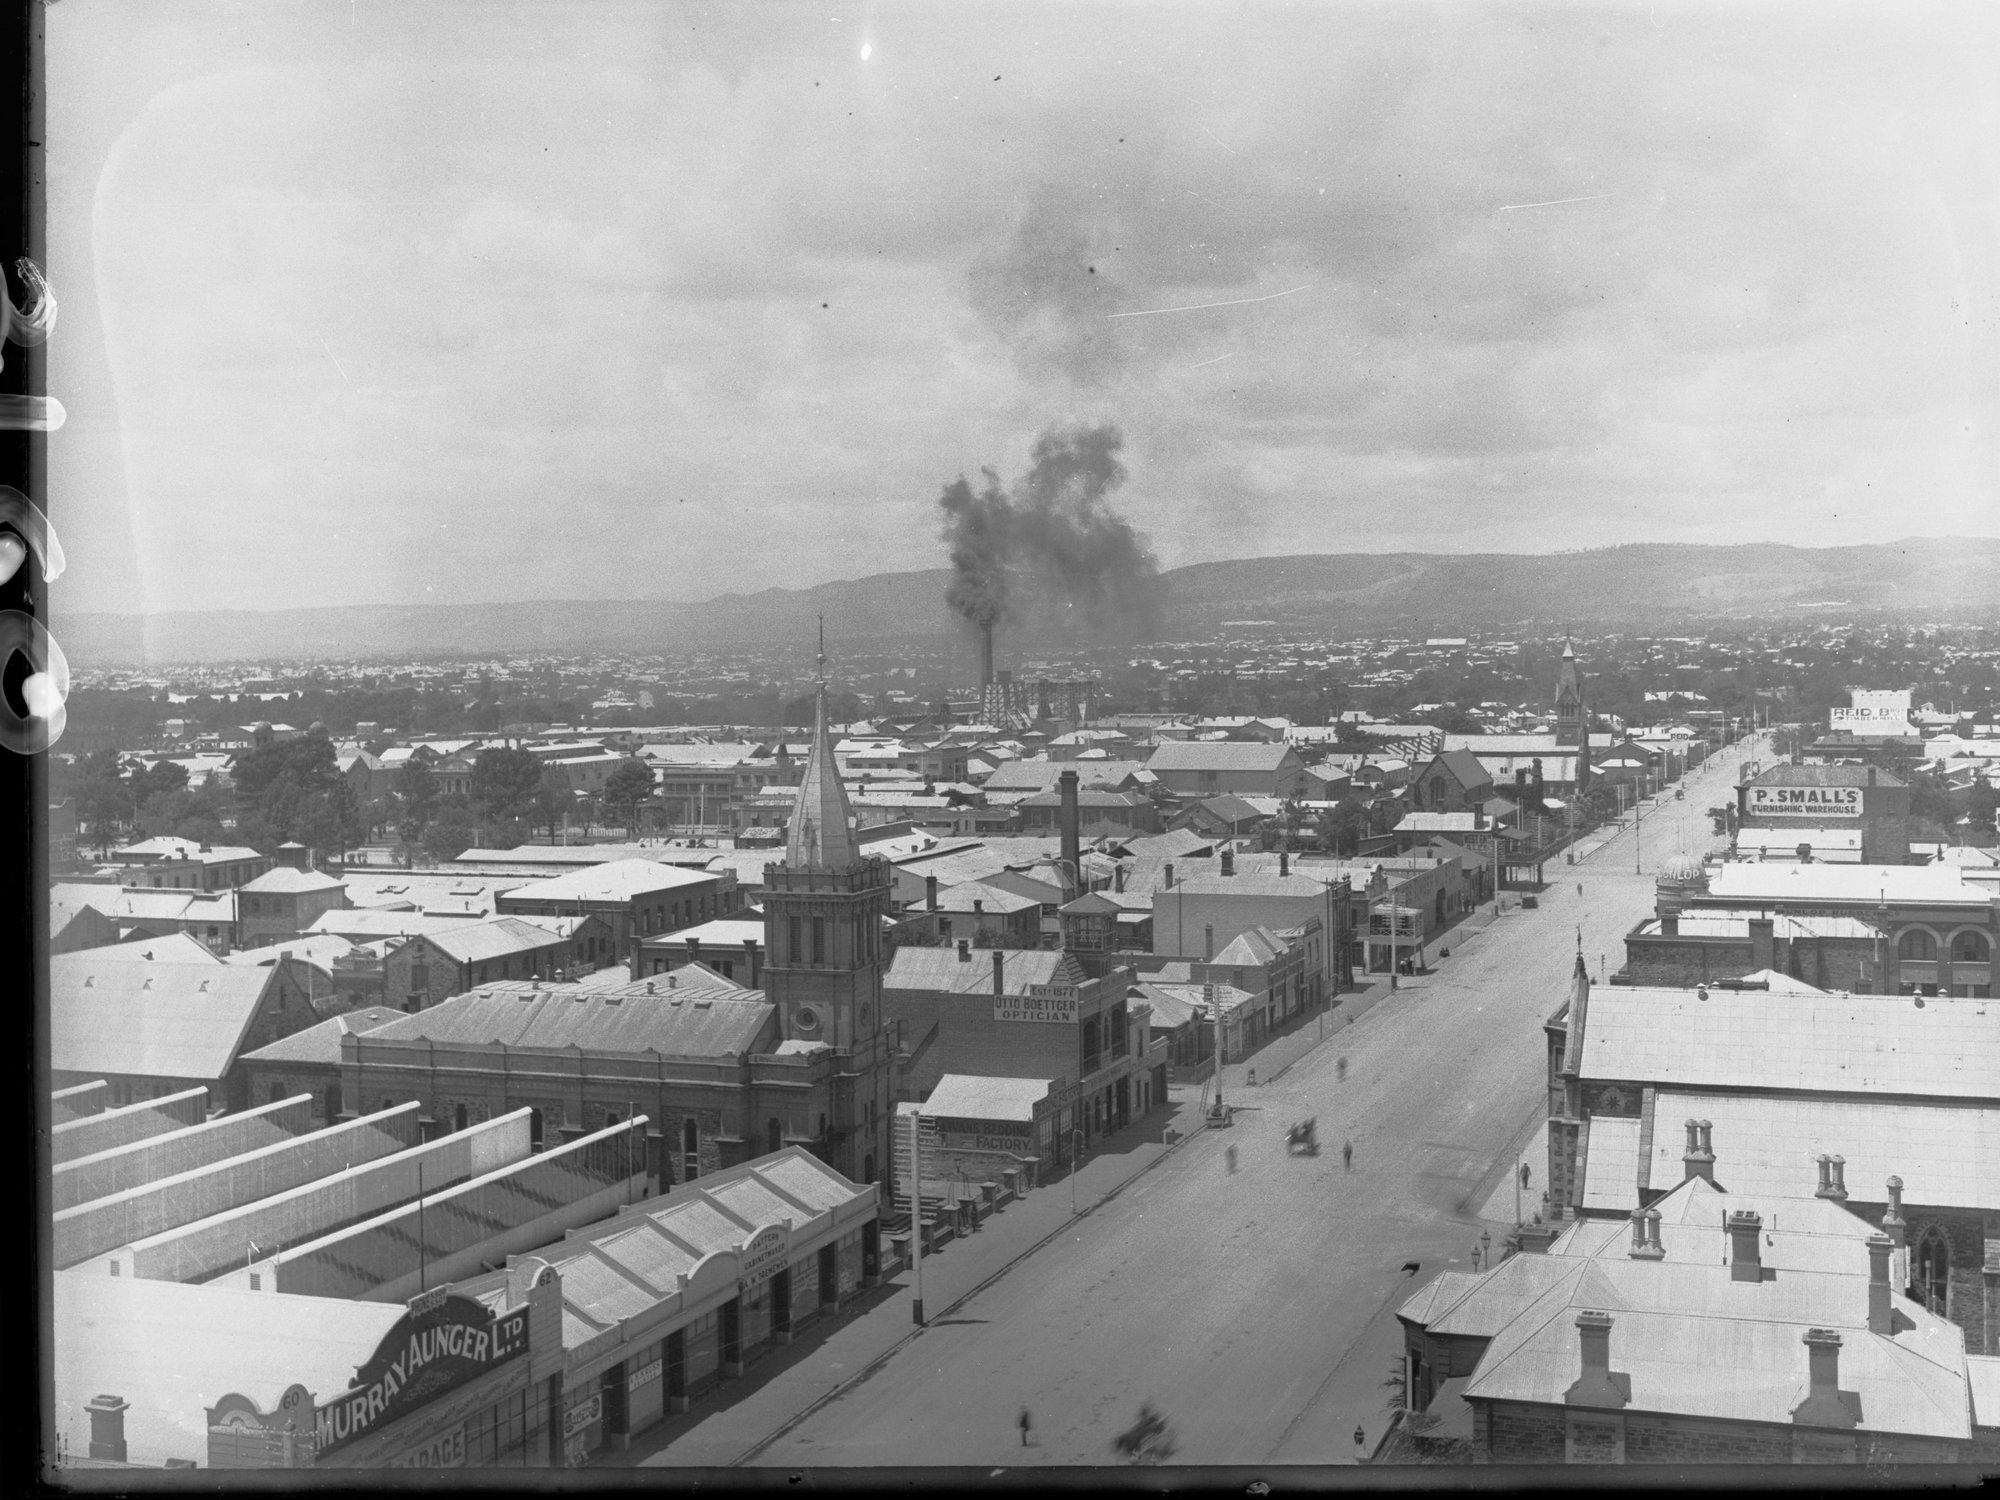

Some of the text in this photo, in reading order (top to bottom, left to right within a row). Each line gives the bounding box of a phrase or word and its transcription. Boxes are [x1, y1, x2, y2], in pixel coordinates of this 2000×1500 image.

[1834, 708, 1871, 716] REID
[1752, 804, 1860, 814] FURNISHING WAREHOUSE.
[995, 996, 1076, 1012] OTTO BOETTGER
[1002, 1010, 1070, 1021] OPTICIAN
[983, 1122, 1031, 1138] BEDDING
[976, 1135, 1033, 1151] FACTORY.
[539, 1272, 551, 1287] 62
[316, 1349, 407, 1451] MURRAY
[409, 1323, 489, 1377] AUNGER
[283, 1391, 300, 1410] 60
